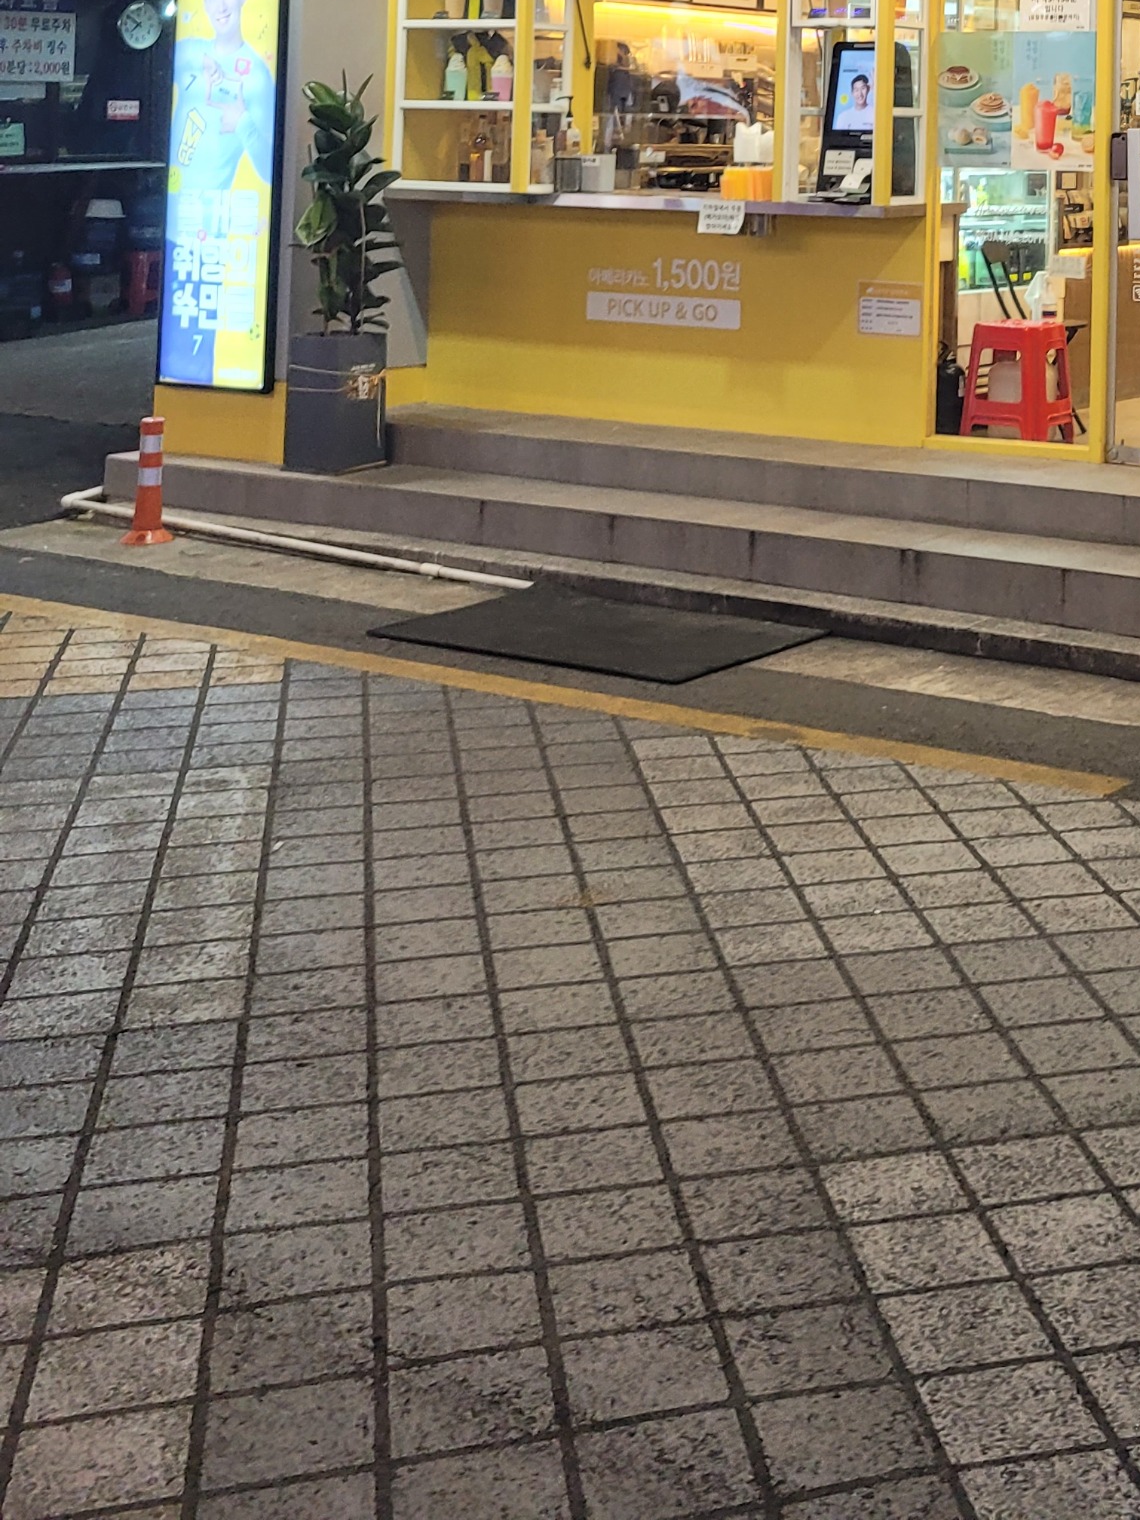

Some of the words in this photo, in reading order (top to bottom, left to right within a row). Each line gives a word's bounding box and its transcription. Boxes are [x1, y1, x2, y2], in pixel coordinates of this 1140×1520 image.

[652, 257, 741, 292] 1,500원
[607, 298, 644, 318] PICK
[648, 301, 671, 319] UP
[675, 302, 687, 320] &
[692, 303, 718, 322] GO
